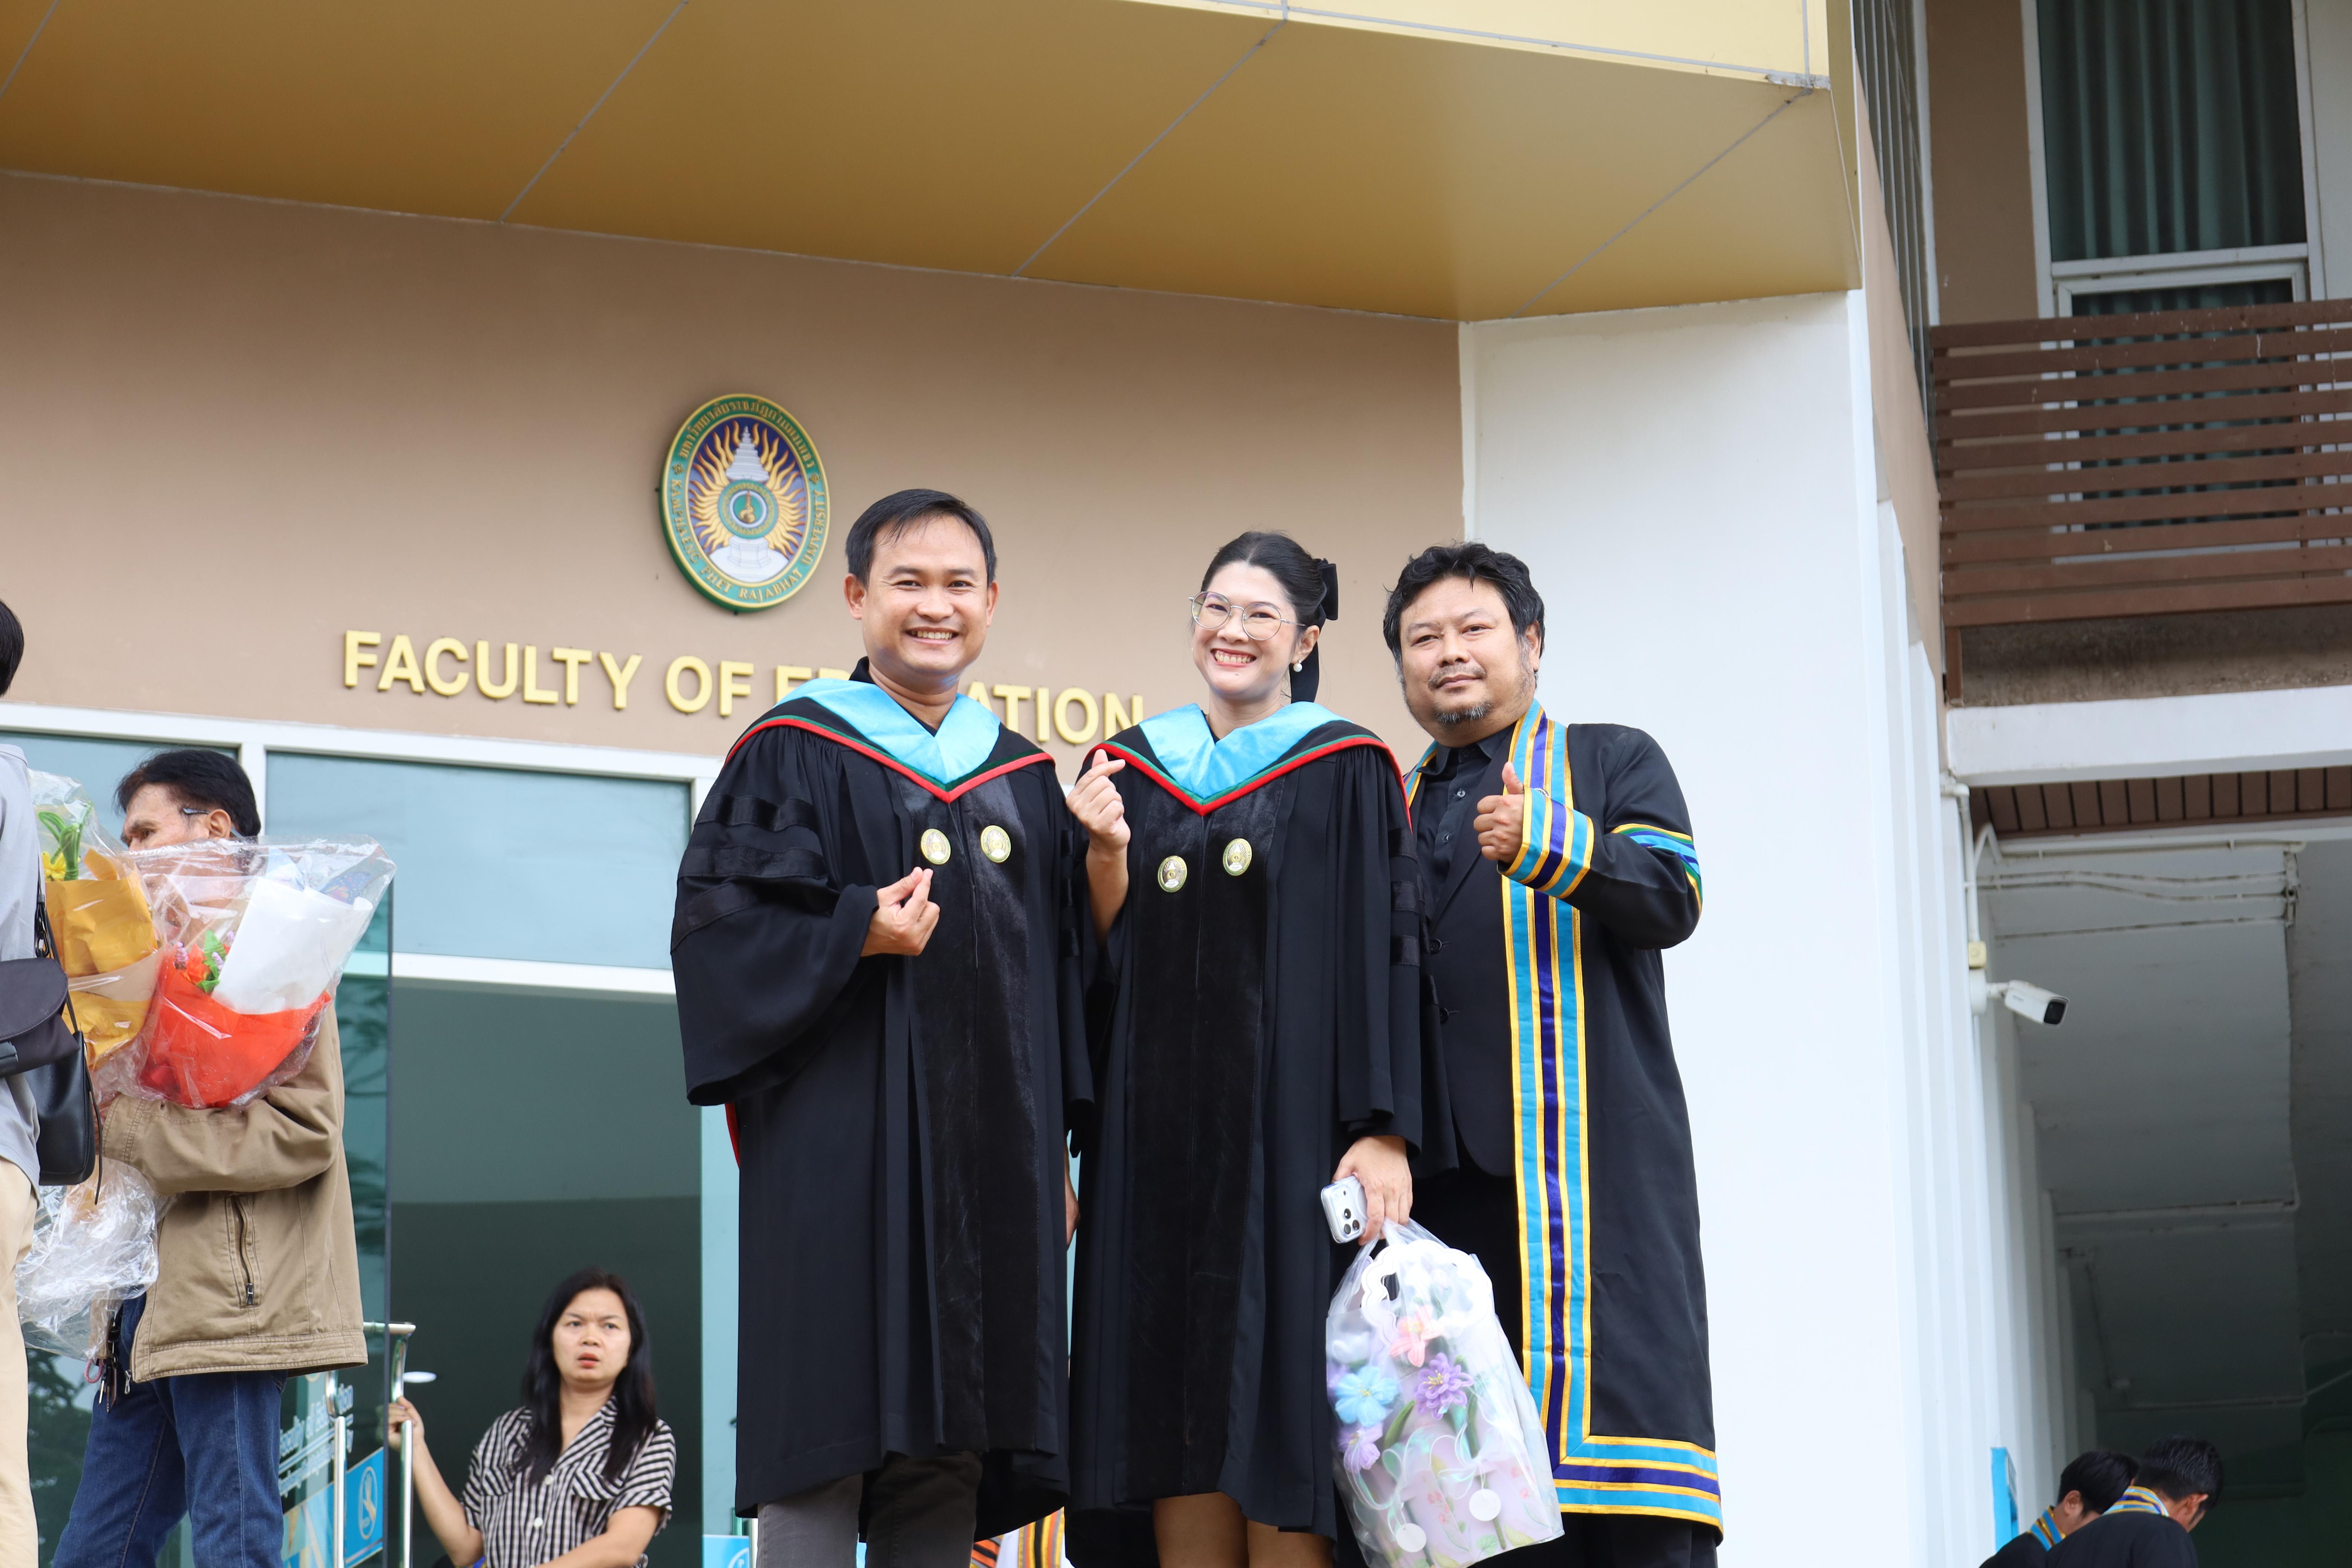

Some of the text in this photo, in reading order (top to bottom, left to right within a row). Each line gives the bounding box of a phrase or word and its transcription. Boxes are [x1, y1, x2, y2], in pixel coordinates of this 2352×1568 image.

[670, 479, 825, 603] KAMPHAENG PHET RAJABHAT UNIVERSITY
[345, 630, 1144, 744] FACULTY OF EATION
[280, 1415, 305, 1457] aculty
